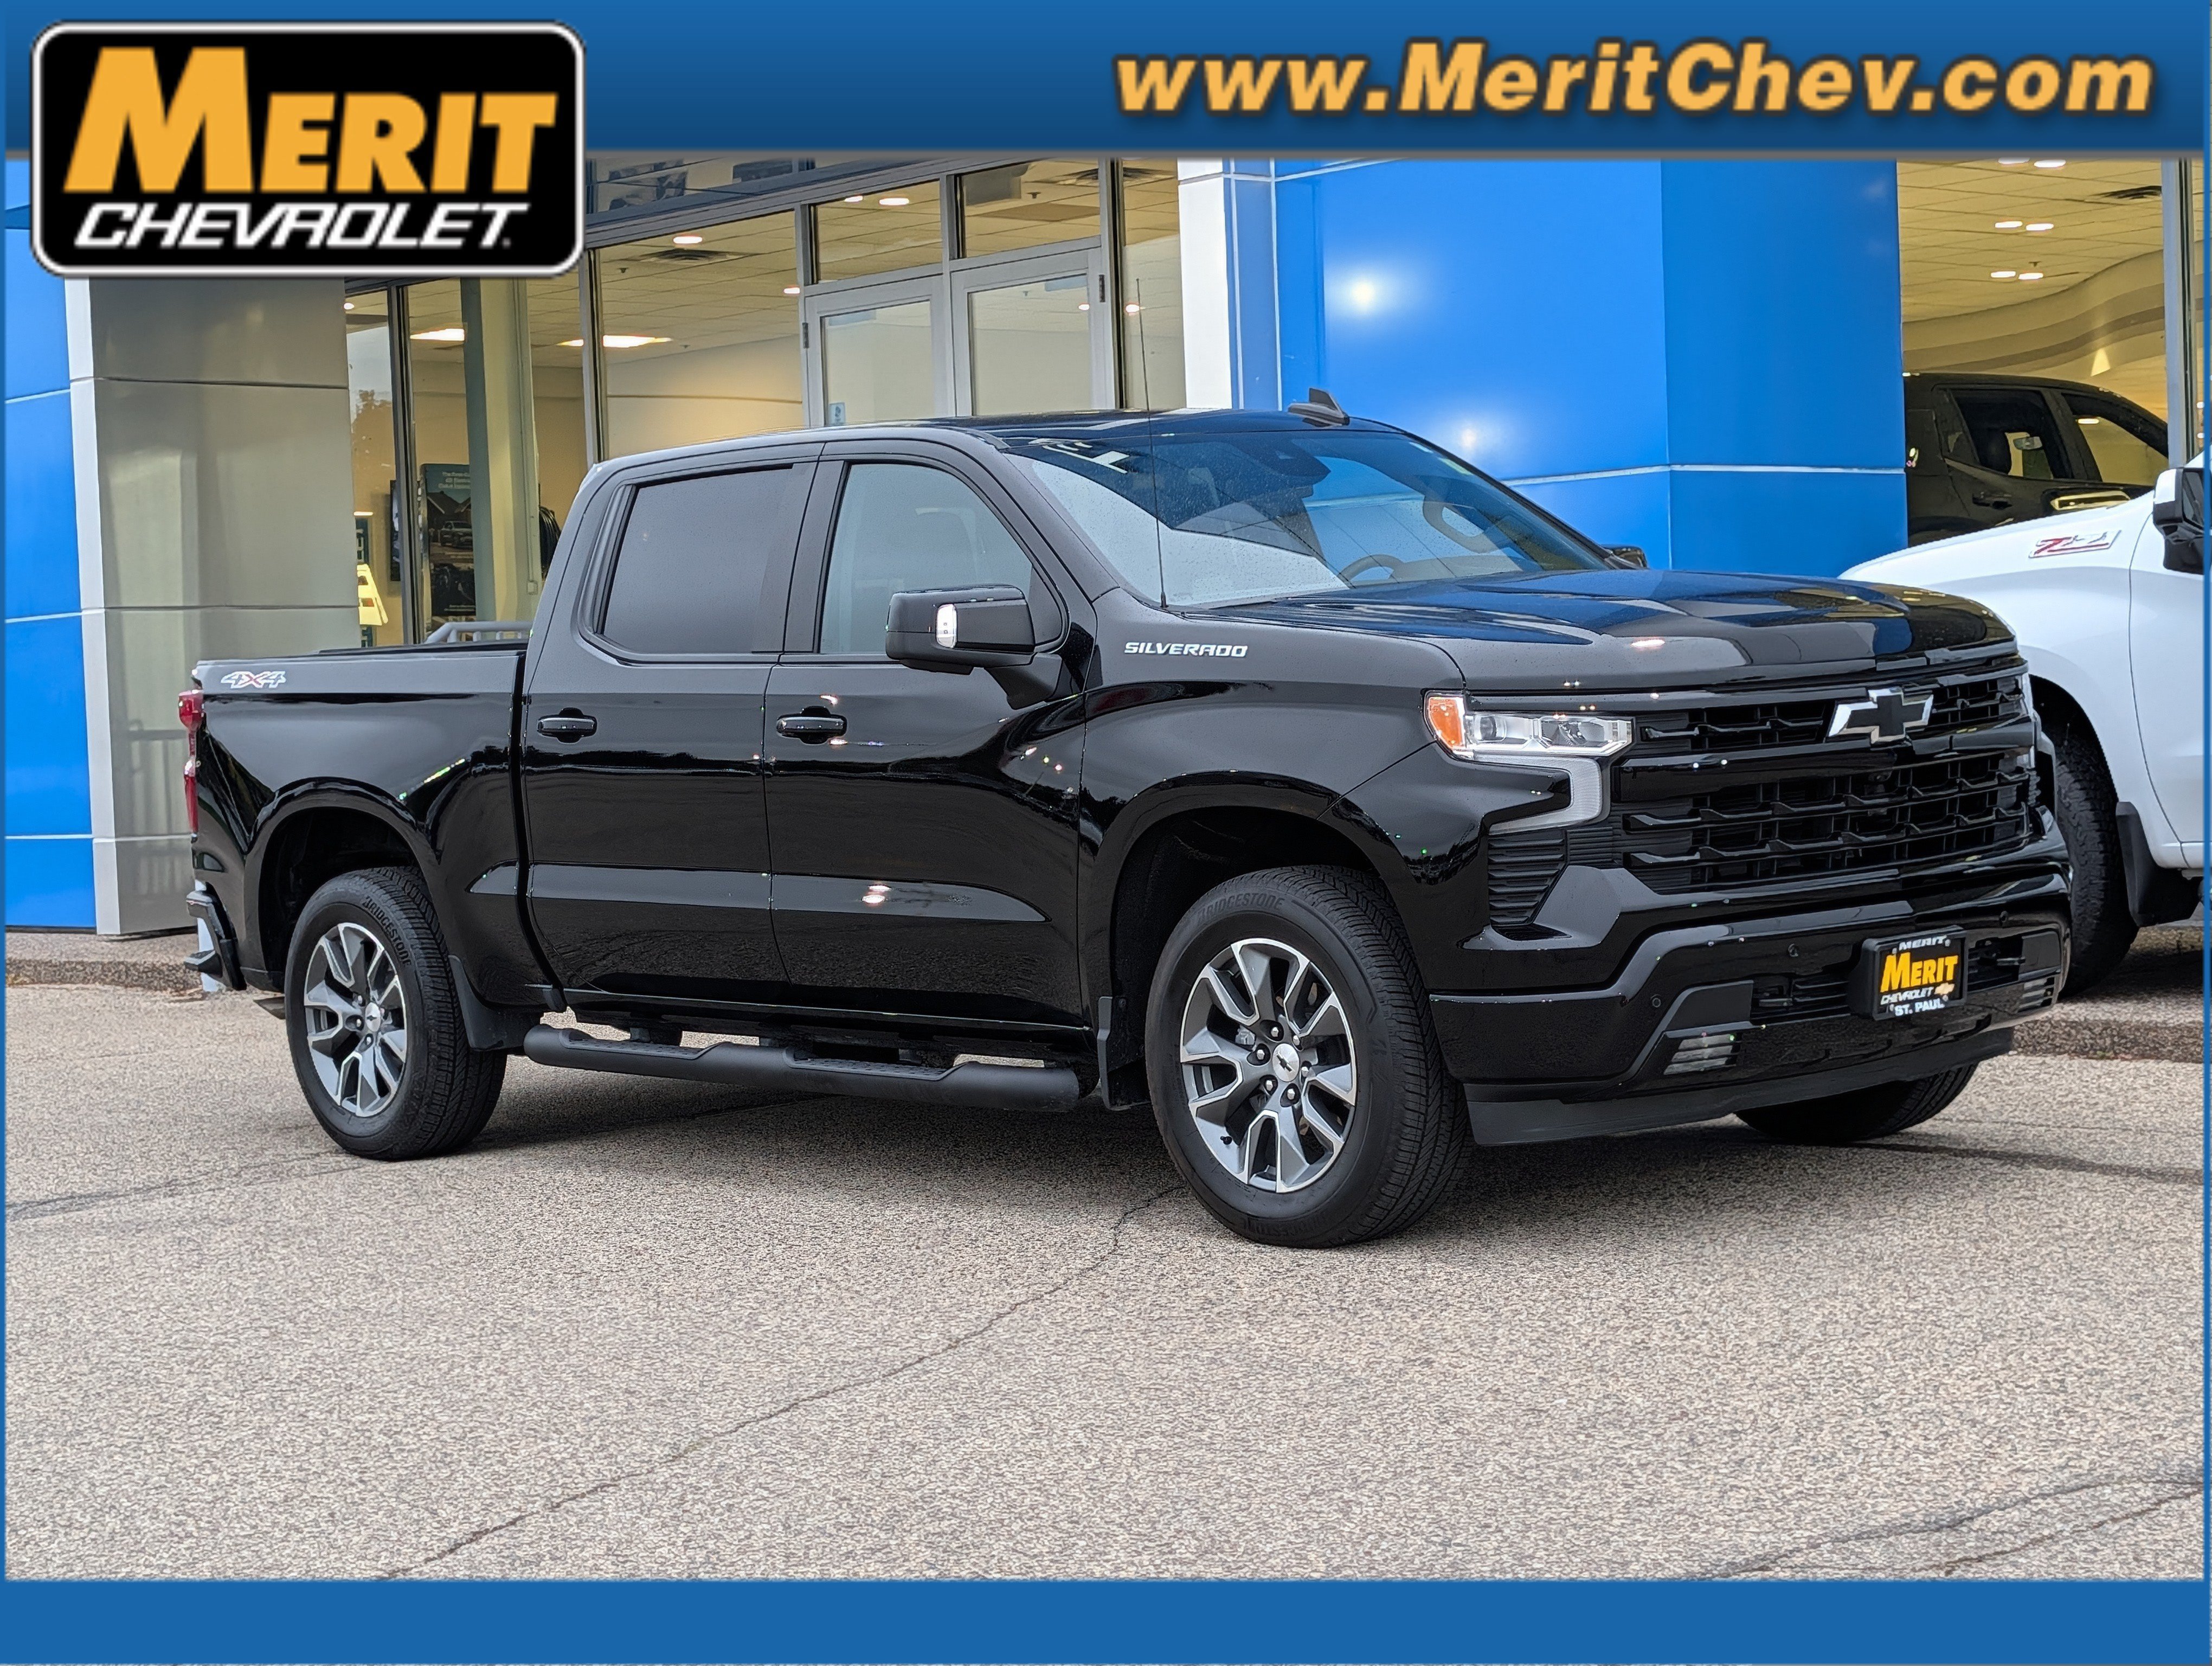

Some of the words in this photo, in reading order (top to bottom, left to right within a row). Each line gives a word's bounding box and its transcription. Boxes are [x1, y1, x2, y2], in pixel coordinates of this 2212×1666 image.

[1124, 642, 1248, 657] SILVERADO
[1197, 893, 1285, 923] BRIDGESTONE
[362, 895, 412, 967] BRIDGESTONE
[1880, 951, 1958, 992] MERIT
[1880, 986, 1934, 1005] CHEVROLET
[1914, 997, 1945, 1013] PAUL
